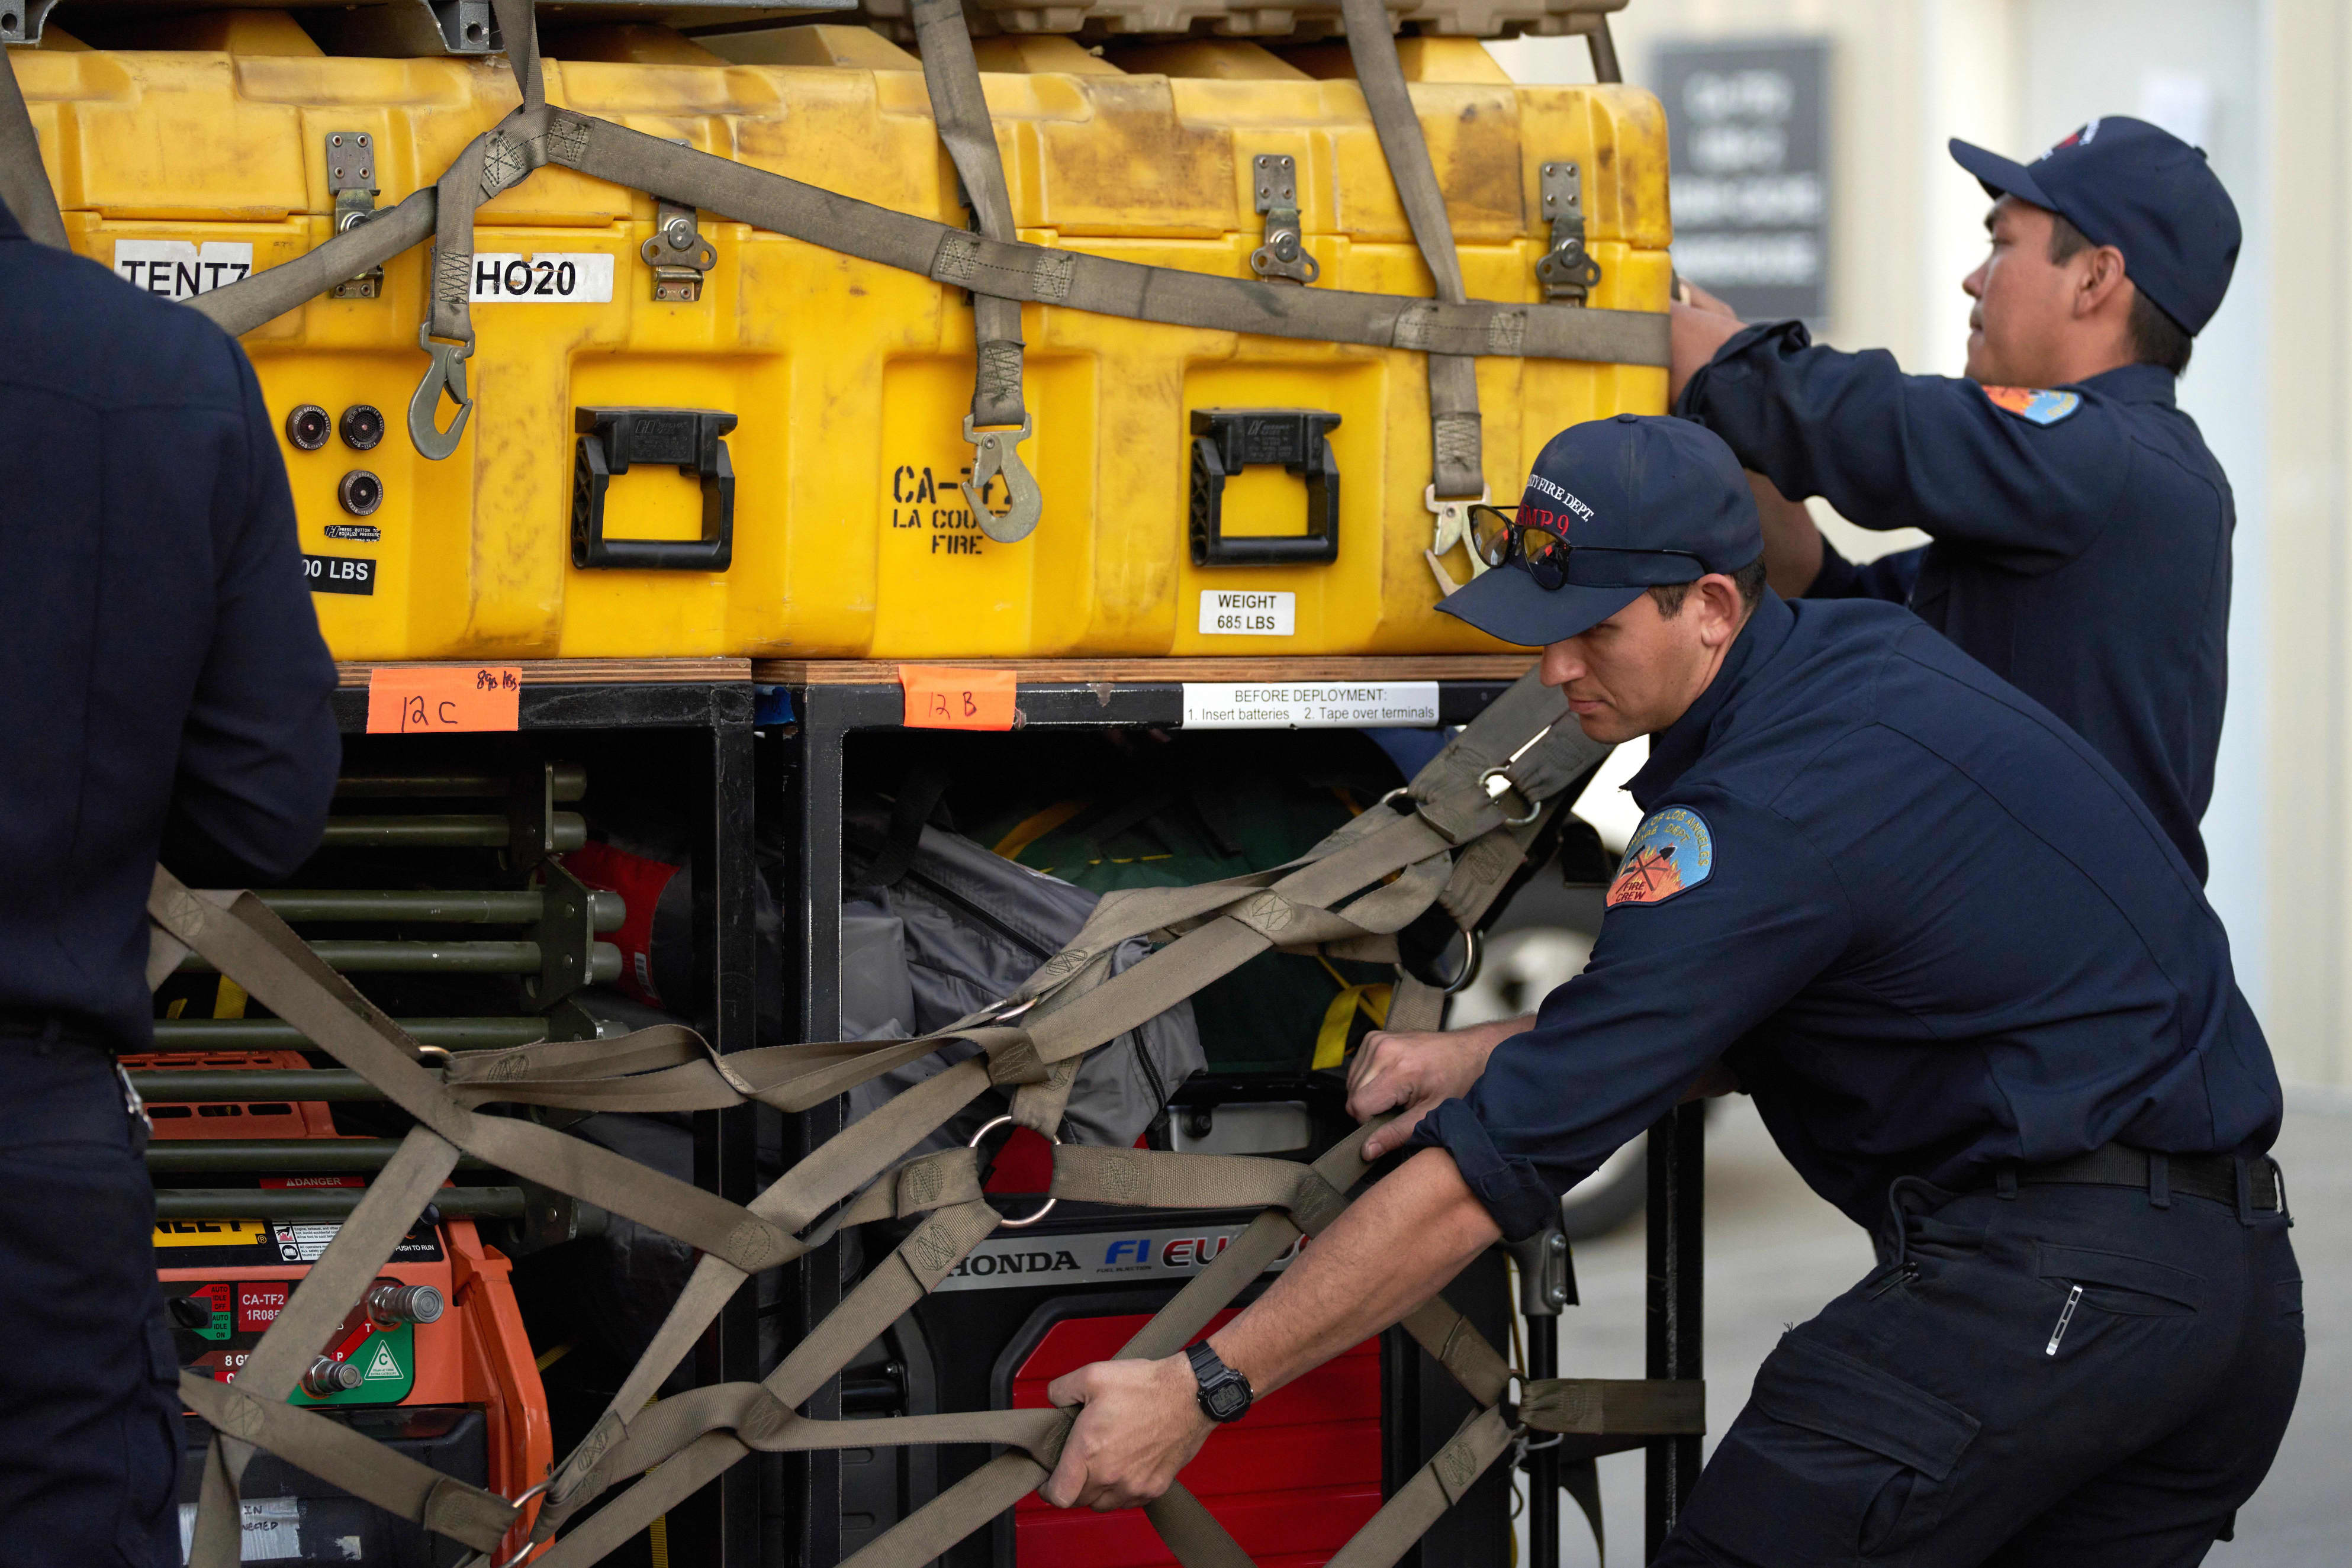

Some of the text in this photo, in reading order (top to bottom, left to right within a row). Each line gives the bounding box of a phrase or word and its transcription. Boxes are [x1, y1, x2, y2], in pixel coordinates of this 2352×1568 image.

[303, 406, 326, 417] BREATHER
[358, 472, 379, 484] BREATHER
[1537, 477, 1566, 501] FIRE
[1562, 492, 1595, 522] DEPT.
[893, 508, 922, 528] LA
[1556, 514, 1569, 536] 9
[932, 535, 983, 555] FIRE
[330, 561, 368, 581] LBS
[1218, 594, 1277, 609] WEIGHT
[1217, 615, 1275, 630] 685 LBS
[1235, 688, 1388, 703] BEFORE DEPLOYMENT:
[929, 691, 977, 720] 12 B
[401, 696, 429, 733] 12
[1188, 705, 1435, 722] 1. Insert batteries 2. Tape over terminals
[1665, 809, 1687, 822] LOS
[1684, 816, 1710, 867] ANGELES
[1623, 881, 1647, 892] FIRE
[1615, 891, 1646, 903] CREW
[294, 1177, 342, 1186] DANGER
[947, 1250, 1082, 1277] HONDA
[1104, 1238, 1151, 1264] FI
[242, 1294, 284, 1305] CA-TF2
[365, 1323, 371, 1332] T
[225, 1355, 233, 1366] 8
[337, 1352, 343, 1361] P
[379, 1353, 388, 1366] C
[244, 1505, 262, 1514] IN
